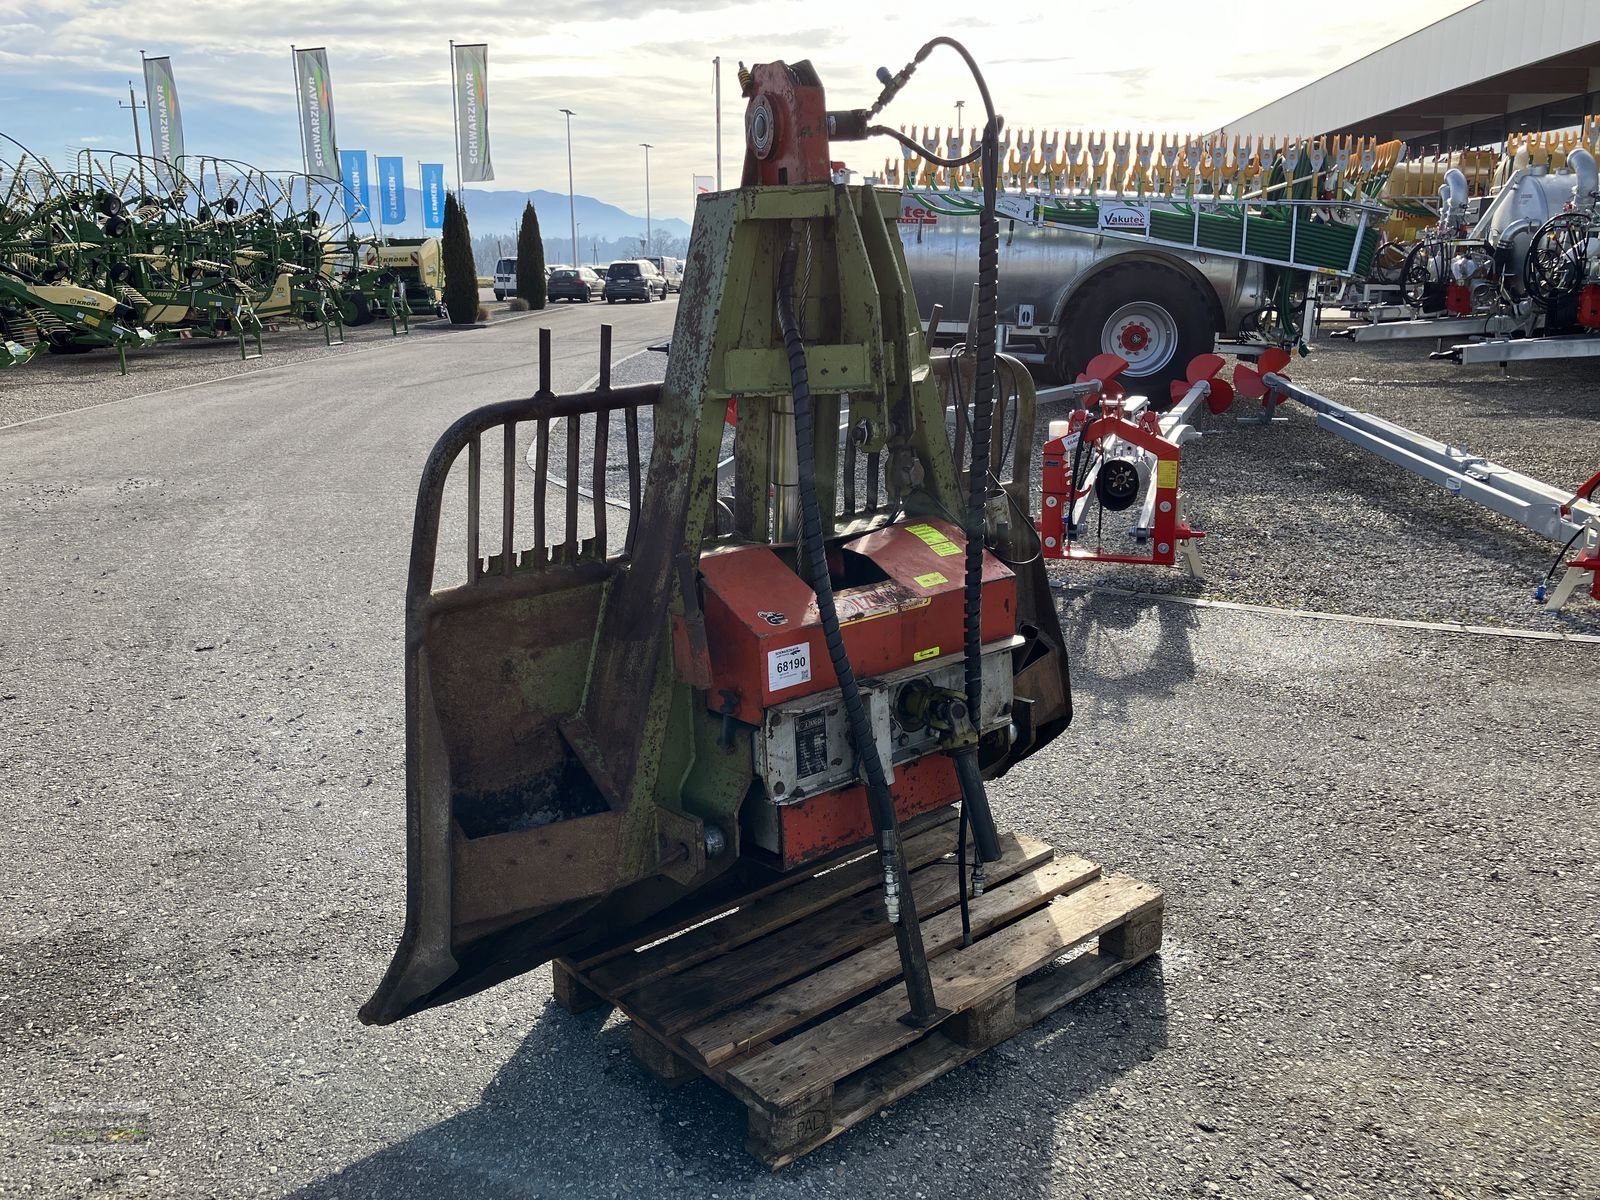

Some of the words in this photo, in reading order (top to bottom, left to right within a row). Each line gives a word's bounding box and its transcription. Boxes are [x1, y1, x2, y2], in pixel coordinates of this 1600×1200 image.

[308, 77, 324, 167] SCHWARZMAYR
[465, 72, 478, 164] SCHWARZMAYR
[388, 176, 397, 210] LEMKEN
[430, 183, 438, 214] LEMKEN
[1104, 212, 1145, 225] Vakutec
[777, 656, 806, 673] 68190
